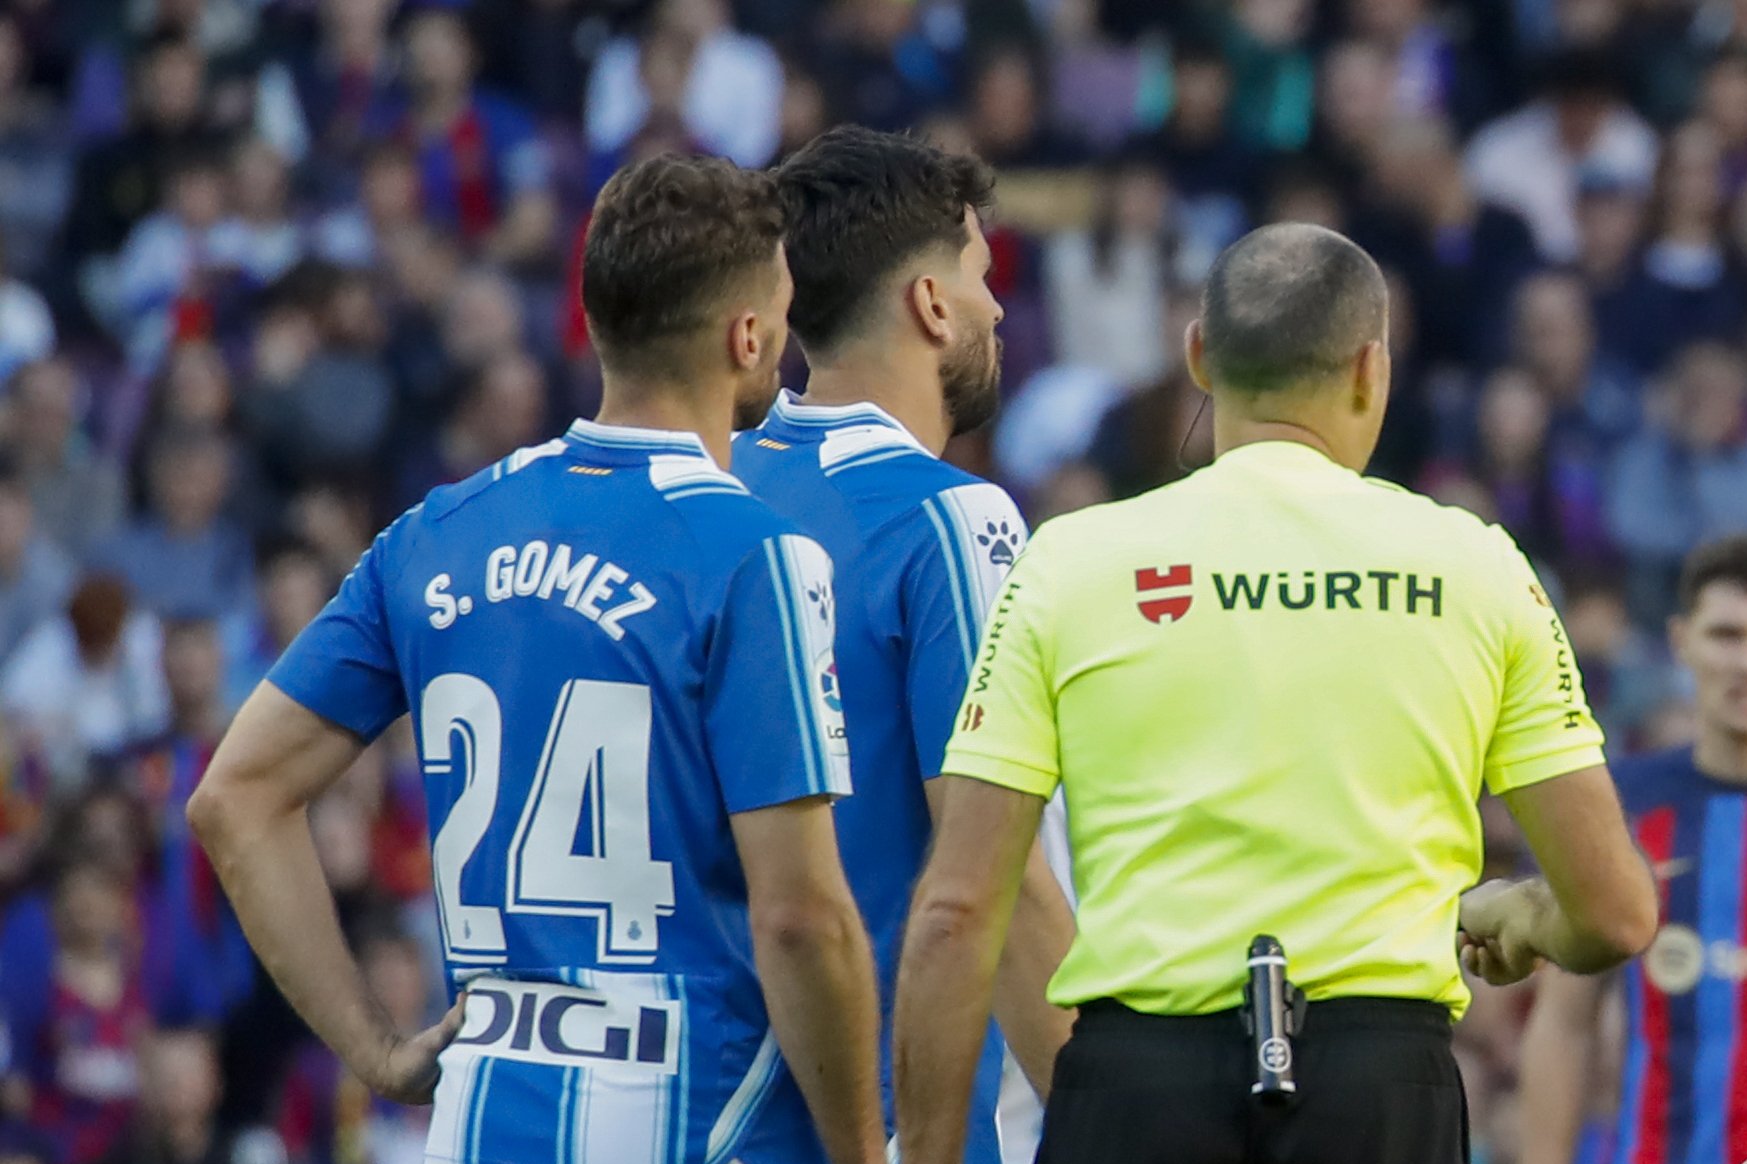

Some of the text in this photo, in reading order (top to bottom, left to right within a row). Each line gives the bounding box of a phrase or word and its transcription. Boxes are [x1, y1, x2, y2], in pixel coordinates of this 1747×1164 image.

[424, 539, 658, 642] S. GOMEZ
[1211, 570, 1443, 617] WÜRTH
[420, 672, 676, 964] 24
[455, 988, 669, 1064] DIGI
